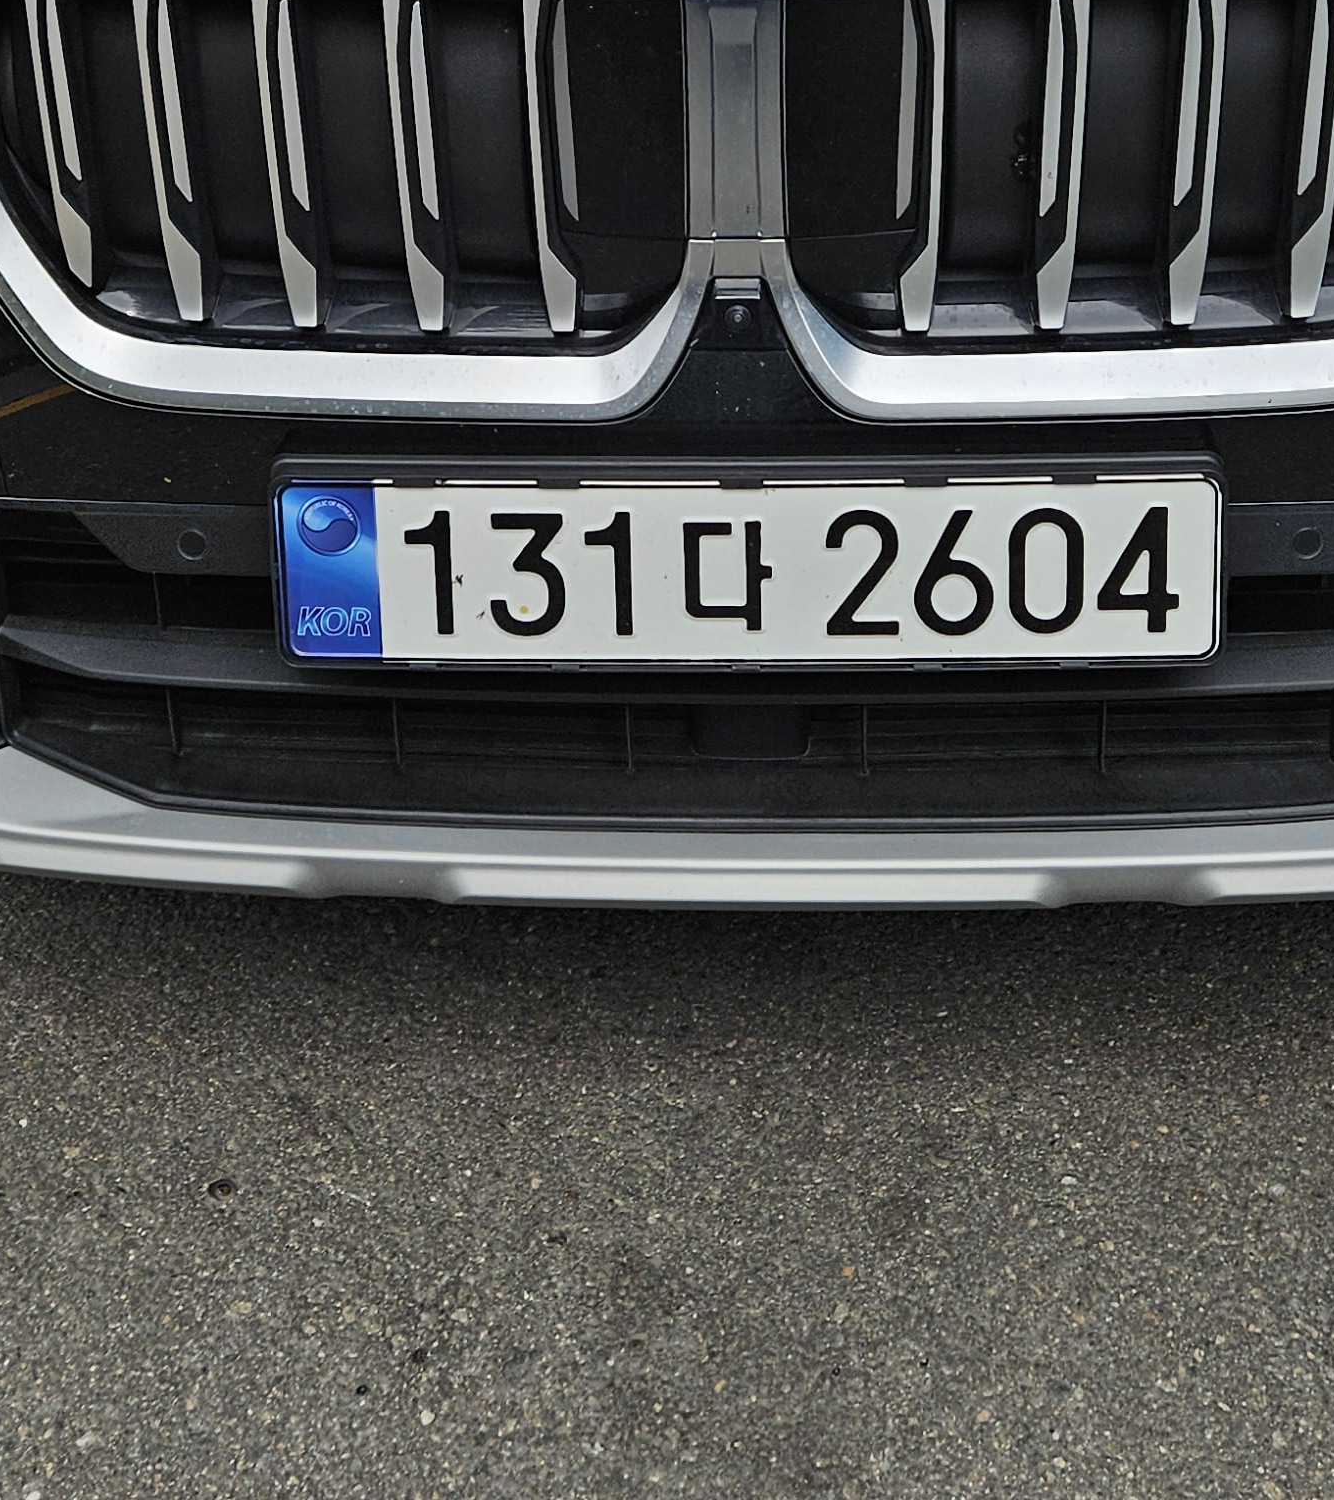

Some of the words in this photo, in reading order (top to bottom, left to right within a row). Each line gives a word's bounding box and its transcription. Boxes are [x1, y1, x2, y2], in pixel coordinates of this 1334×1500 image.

[403, 508, 773, 636] 131다
[823, 506, 1180, 637] 2604
[297, 605, 372, 637] KOR
